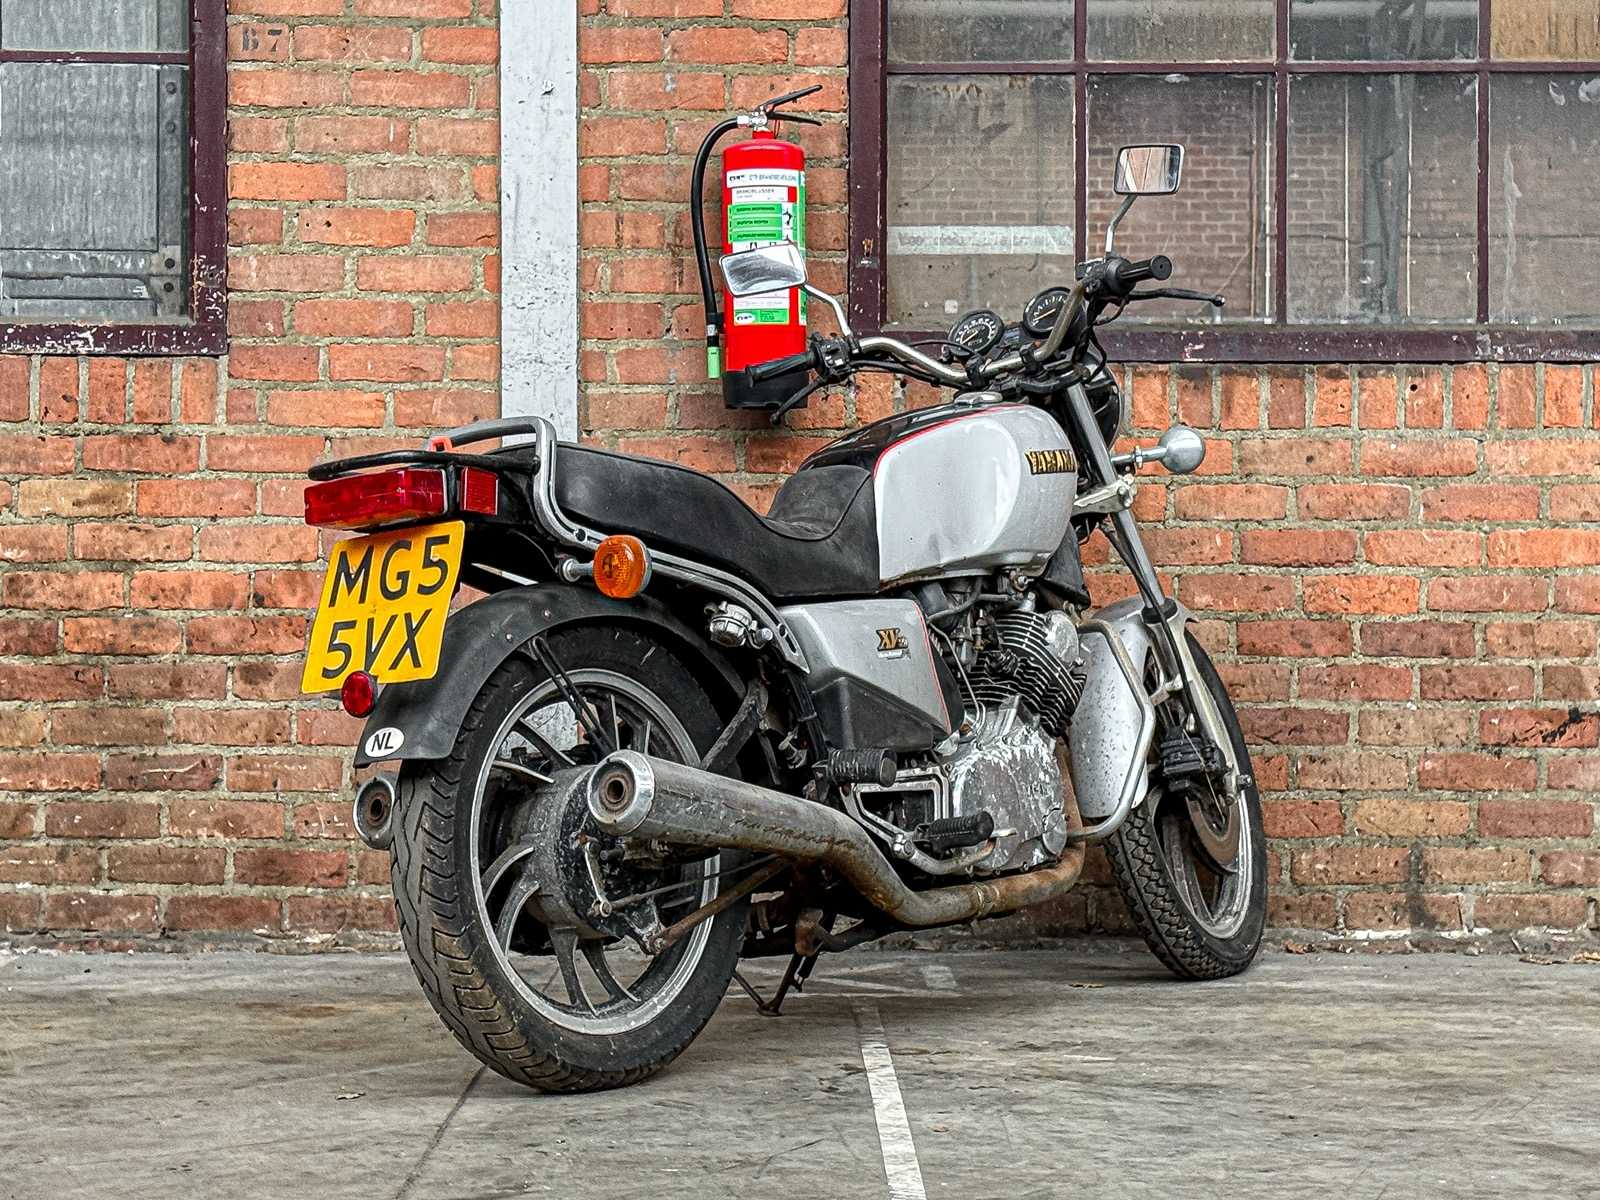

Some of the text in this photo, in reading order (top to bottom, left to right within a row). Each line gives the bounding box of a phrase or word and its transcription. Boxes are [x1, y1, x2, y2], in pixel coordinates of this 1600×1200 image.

[328, 534, 450, 608] MG5
[321, 608, 433, 679] 5VX
[371, 732, 394, 753] NL
